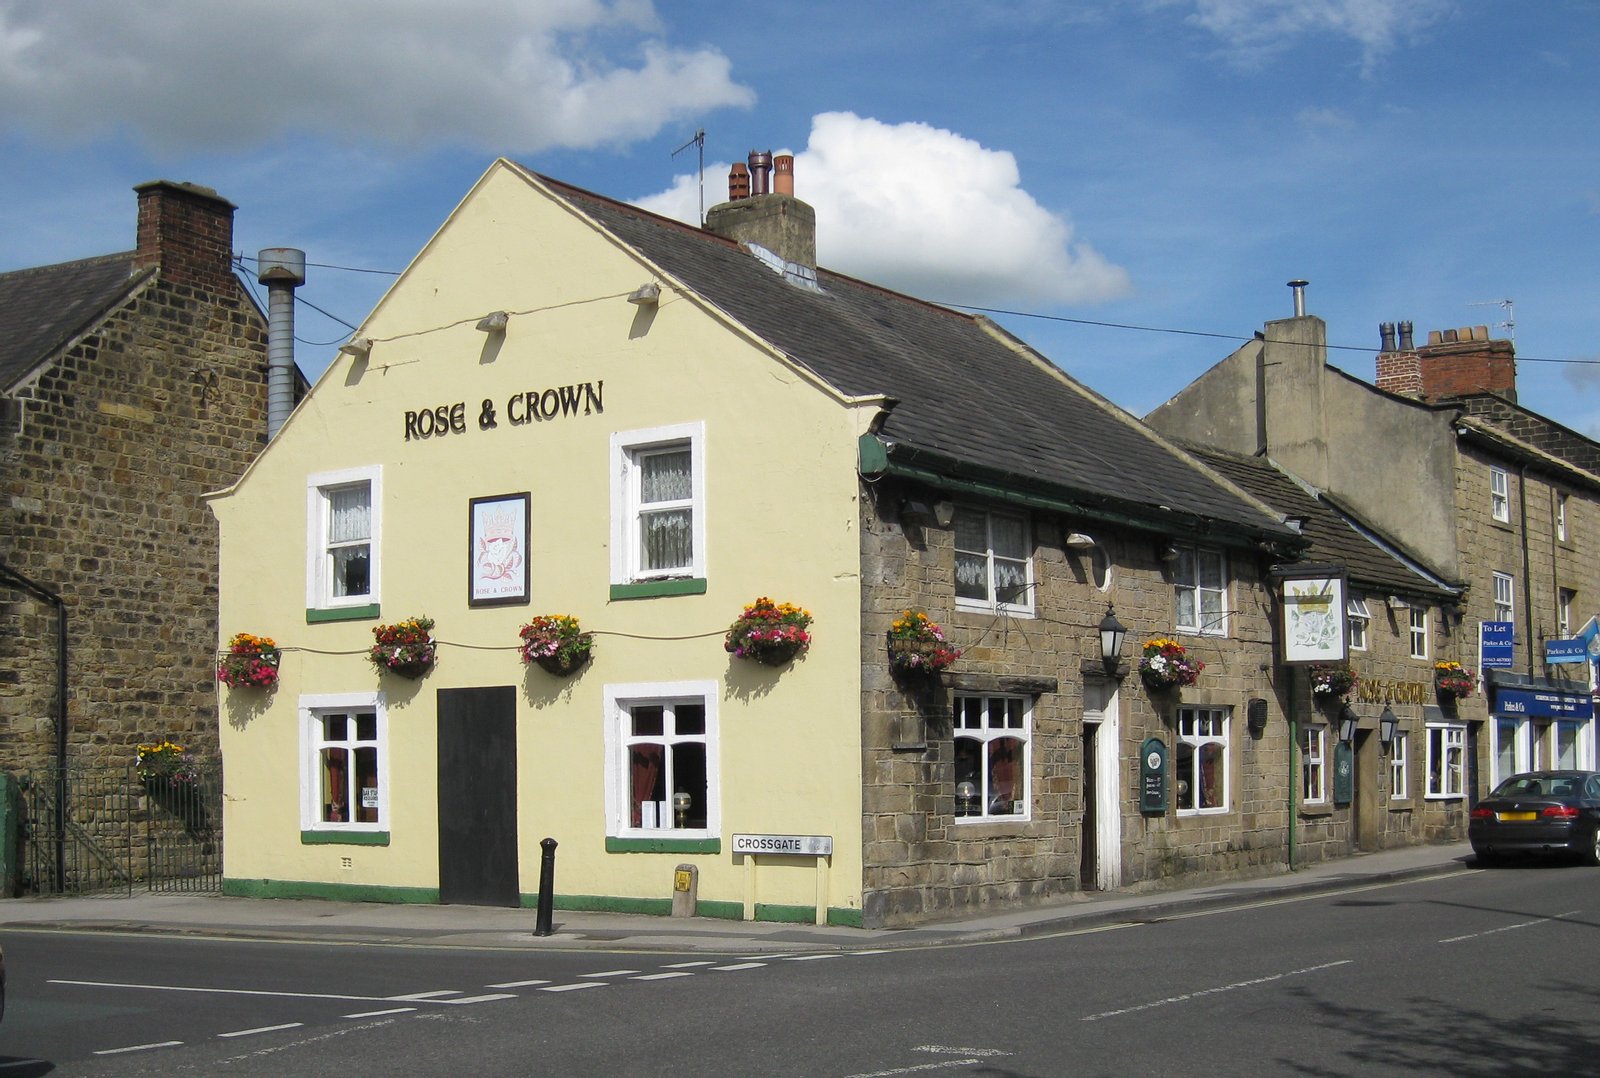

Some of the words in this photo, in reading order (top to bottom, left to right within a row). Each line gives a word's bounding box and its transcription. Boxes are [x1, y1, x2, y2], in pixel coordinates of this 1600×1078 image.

[404, 401, 466, 442] ROSE
[478, 398, 498, 431] &
[507, 380, 604, 427] CROWN
[475, 587, 490, 595] ROSE
[500, 585, 523, 593] CROWN
[1483, 624, 1492, 632] To
[1494, 624, 1506, 632] Let
[737, 838, 801, 850] CROSSGATE
